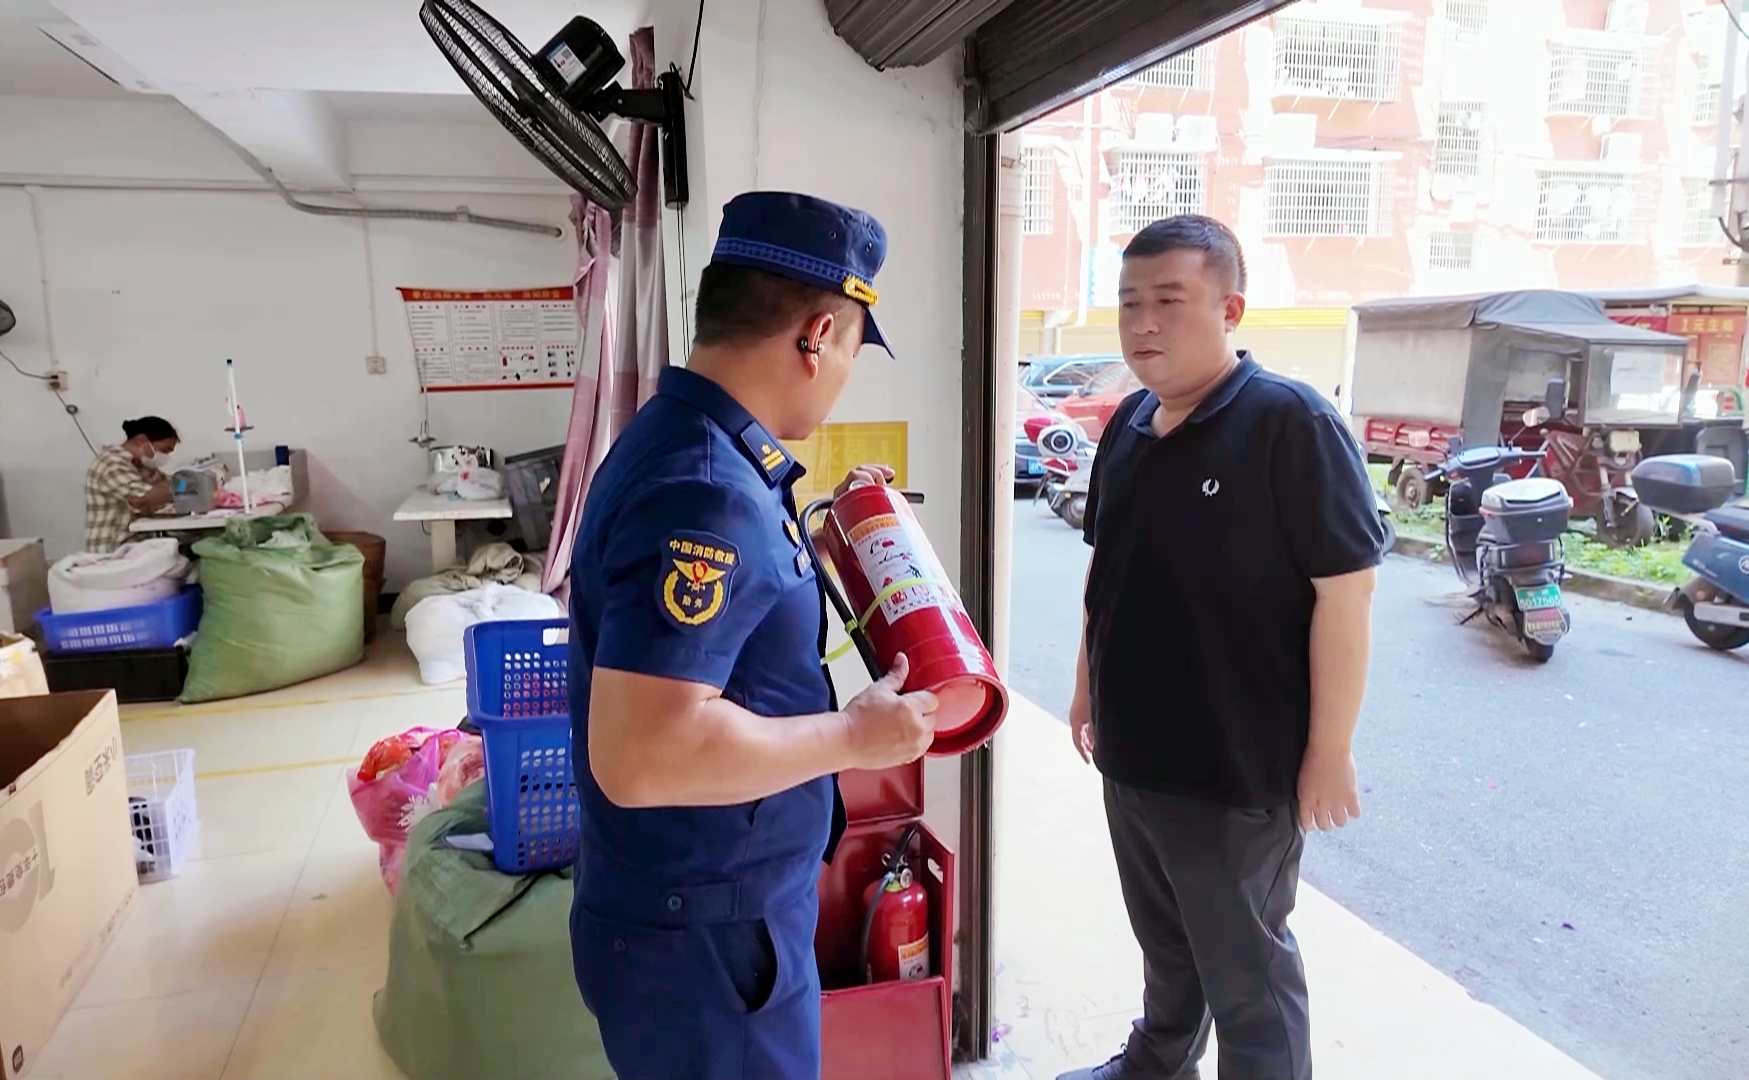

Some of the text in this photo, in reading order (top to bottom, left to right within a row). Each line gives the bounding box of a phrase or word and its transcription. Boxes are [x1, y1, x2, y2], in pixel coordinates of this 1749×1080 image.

[669, 539, 735, 566] 中国消防救援
